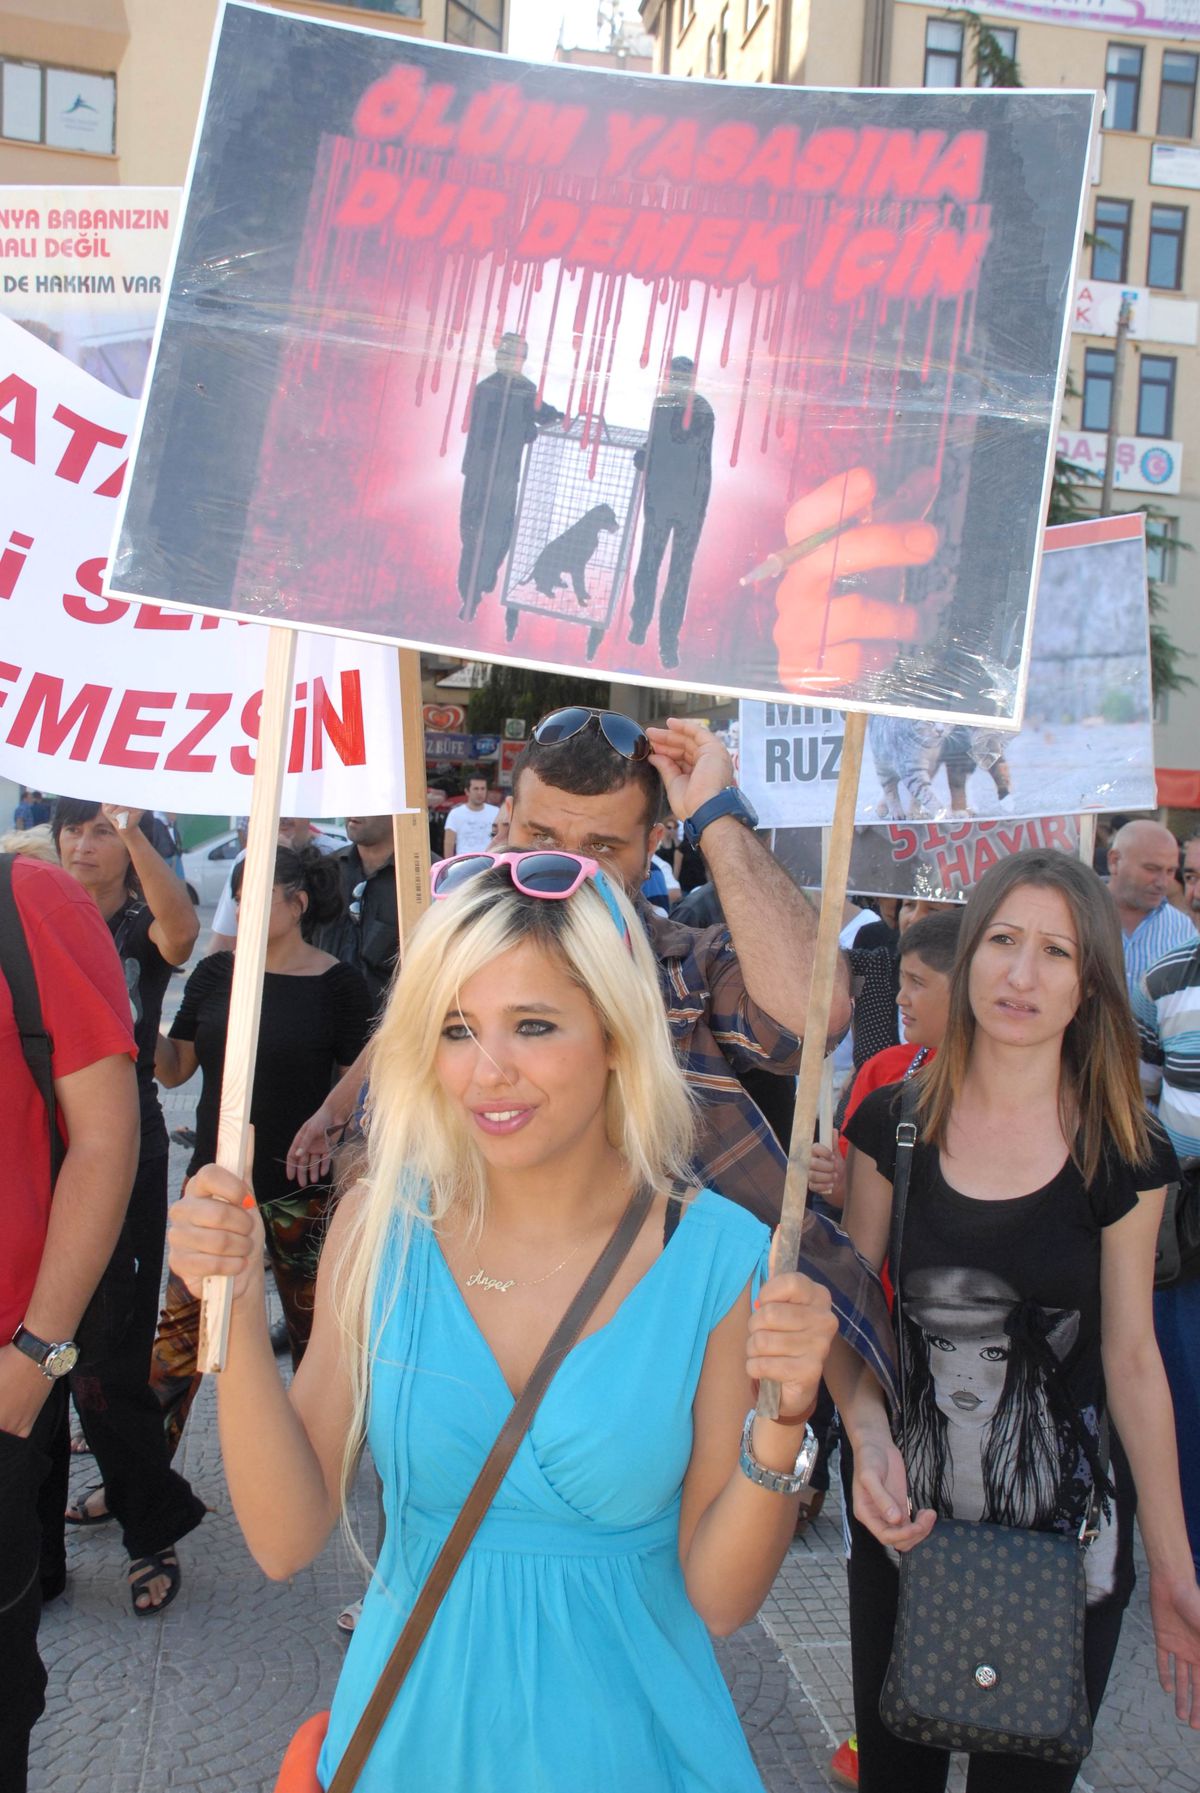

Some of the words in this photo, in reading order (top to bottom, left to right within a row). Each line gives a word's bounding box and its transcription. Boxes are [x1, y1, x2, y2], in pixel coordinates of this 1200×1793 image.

[354, 63, 588, 166] ÖLÜM
[604, 112, 988, 199] YASASINA
[47, 209, 169, 230] BABANIZIN
[333, 168, 508, 249] DUR
[516, 201, 799, 288] DEMEK
[0, 238, 37, 258] ALI
[45, 233, 111, 258] DEĞİL
[4, 275, 29, 293] DE
[36, 275, 115, 293] HAKKIM
[122, 275, 161, 293] VAR
[0, 373, 129, 499] AT
[766, 735, 844, 783] RUZ
[888, 820, 996, 861] 51
